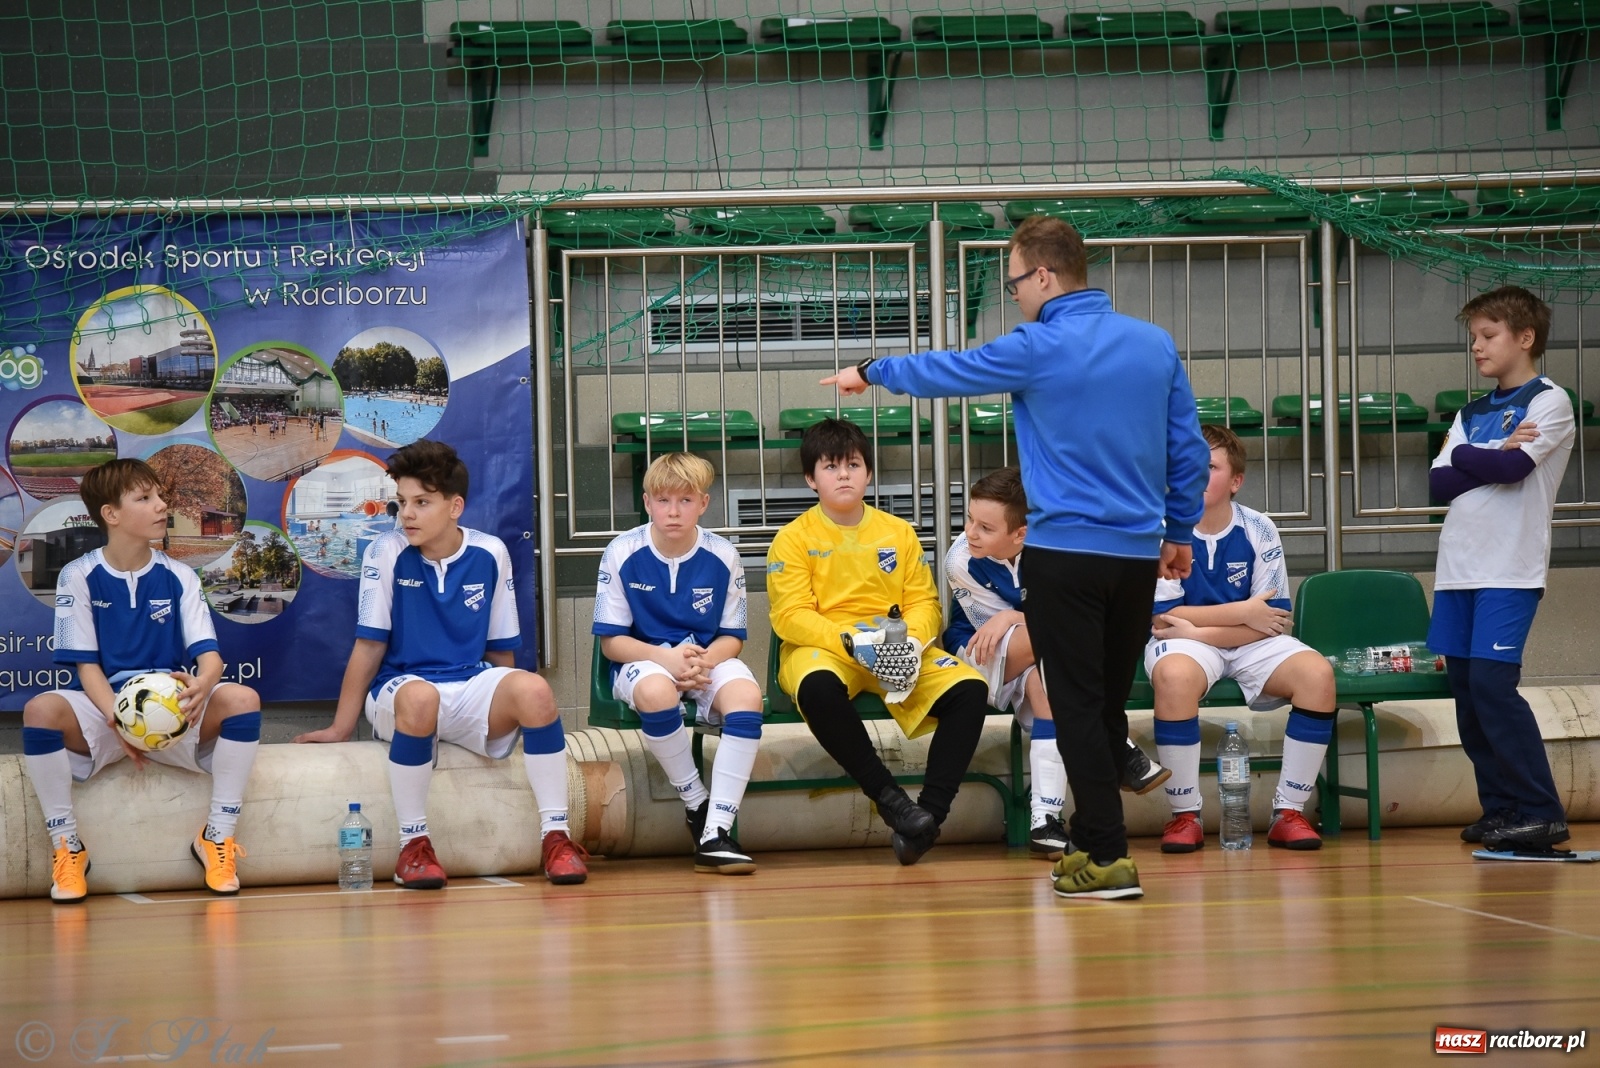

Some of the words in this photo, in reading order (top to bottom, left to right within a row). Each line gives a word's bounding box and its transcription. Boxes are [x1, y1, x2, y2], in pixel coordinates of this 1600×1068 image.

[25, 244, 154, 269] Ośrodek
[164, 244, 261, 273] Sportu
[272, 246, 279, 267] i
[291, 243, 426, 272] Rekreacji
[244, 287, 272, 305] w
[282, 281, 427, 306] Raciborzu
[629, 582, 656, 592] saller
